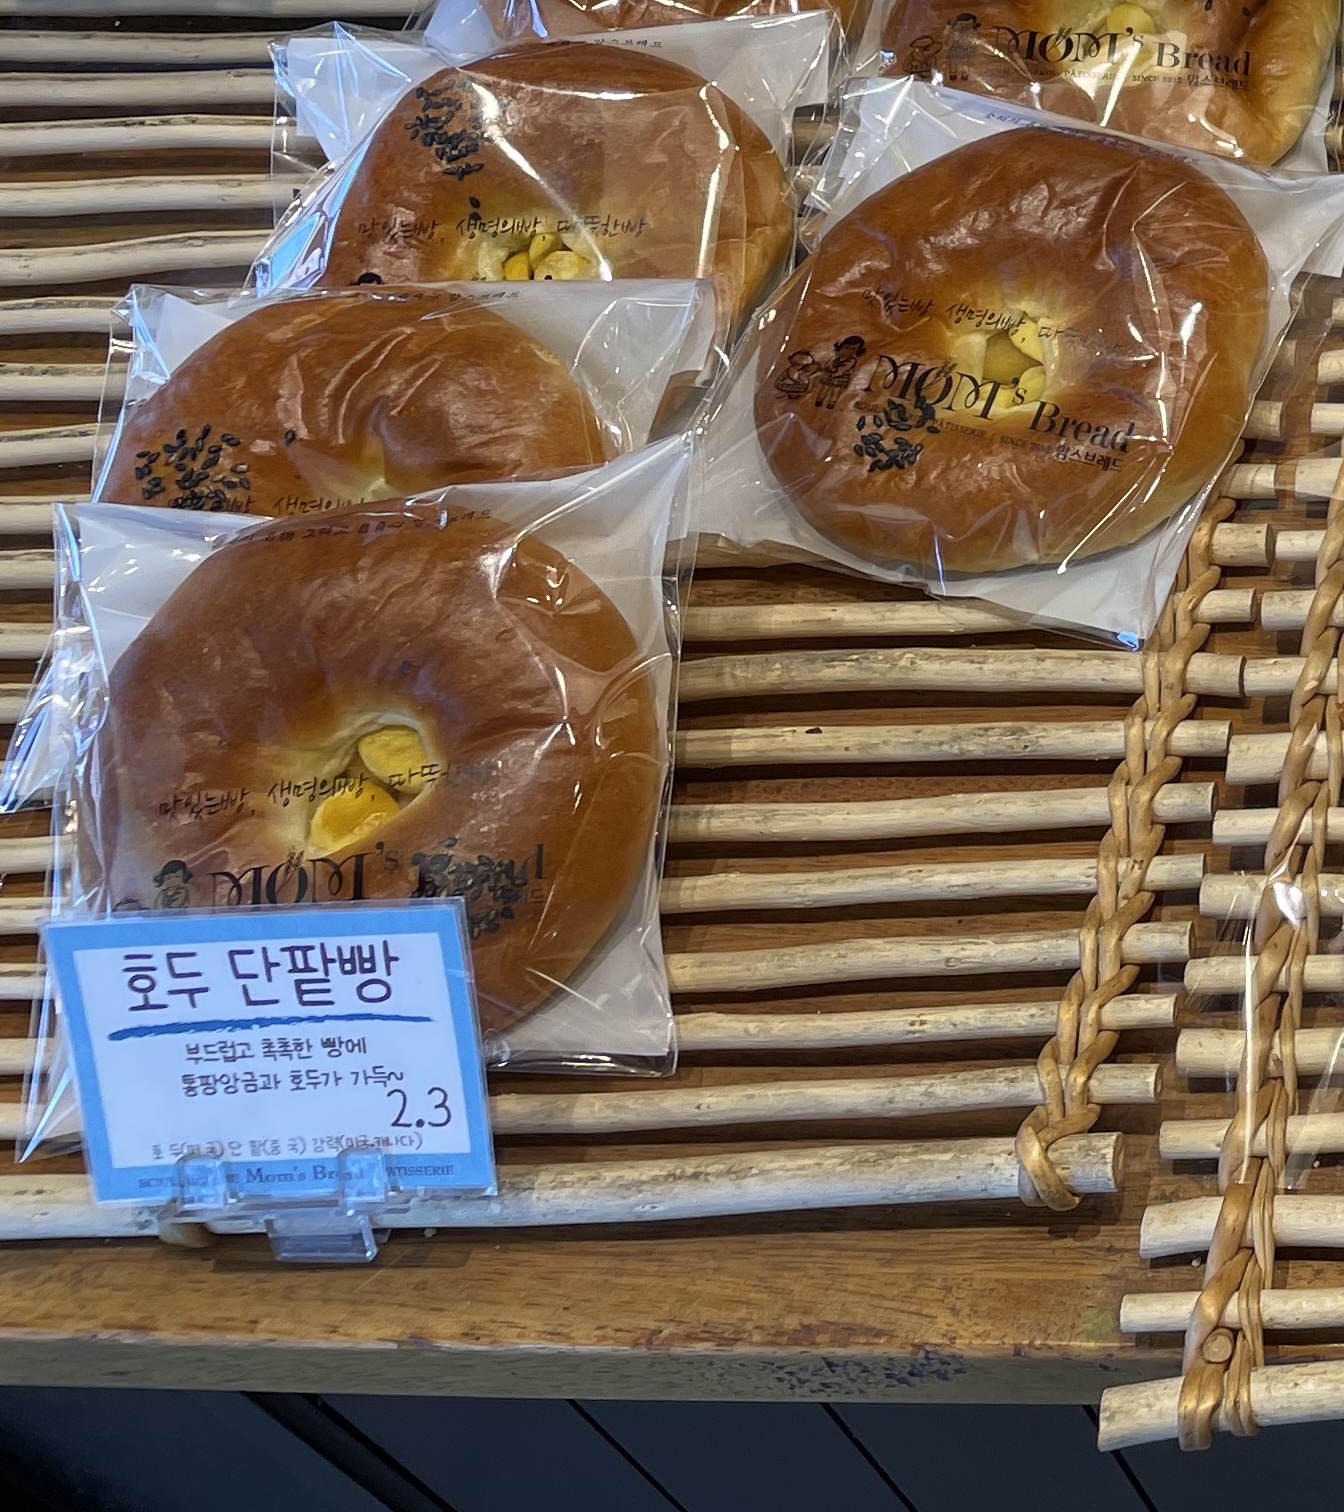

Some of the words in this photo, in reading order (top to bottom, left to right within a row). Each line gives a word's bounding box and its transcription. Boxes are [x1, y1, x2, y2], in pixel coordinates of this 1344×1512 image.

[1154, 41, 1249, 77] Bread
[864, 354, 1028, 421] MOM's
[1028, 400, 1137, 454] Bread
[121, 951, 209, 1012] 호두
[227, 940, 400, 1008] 단팥빵
[185, 1042, 254, 1064] 부드럽고
[262, 1039, 313, 1061] 촉촉한
[321, 1037, 367, 1057] 빵에
[290, 1069, 342, 1091] 호두가
[351, 1066, 404, 1088] 가득~
[387, 1087, 452, 1128] 2.3
[246, 1167, 306, 1183] Mom's
